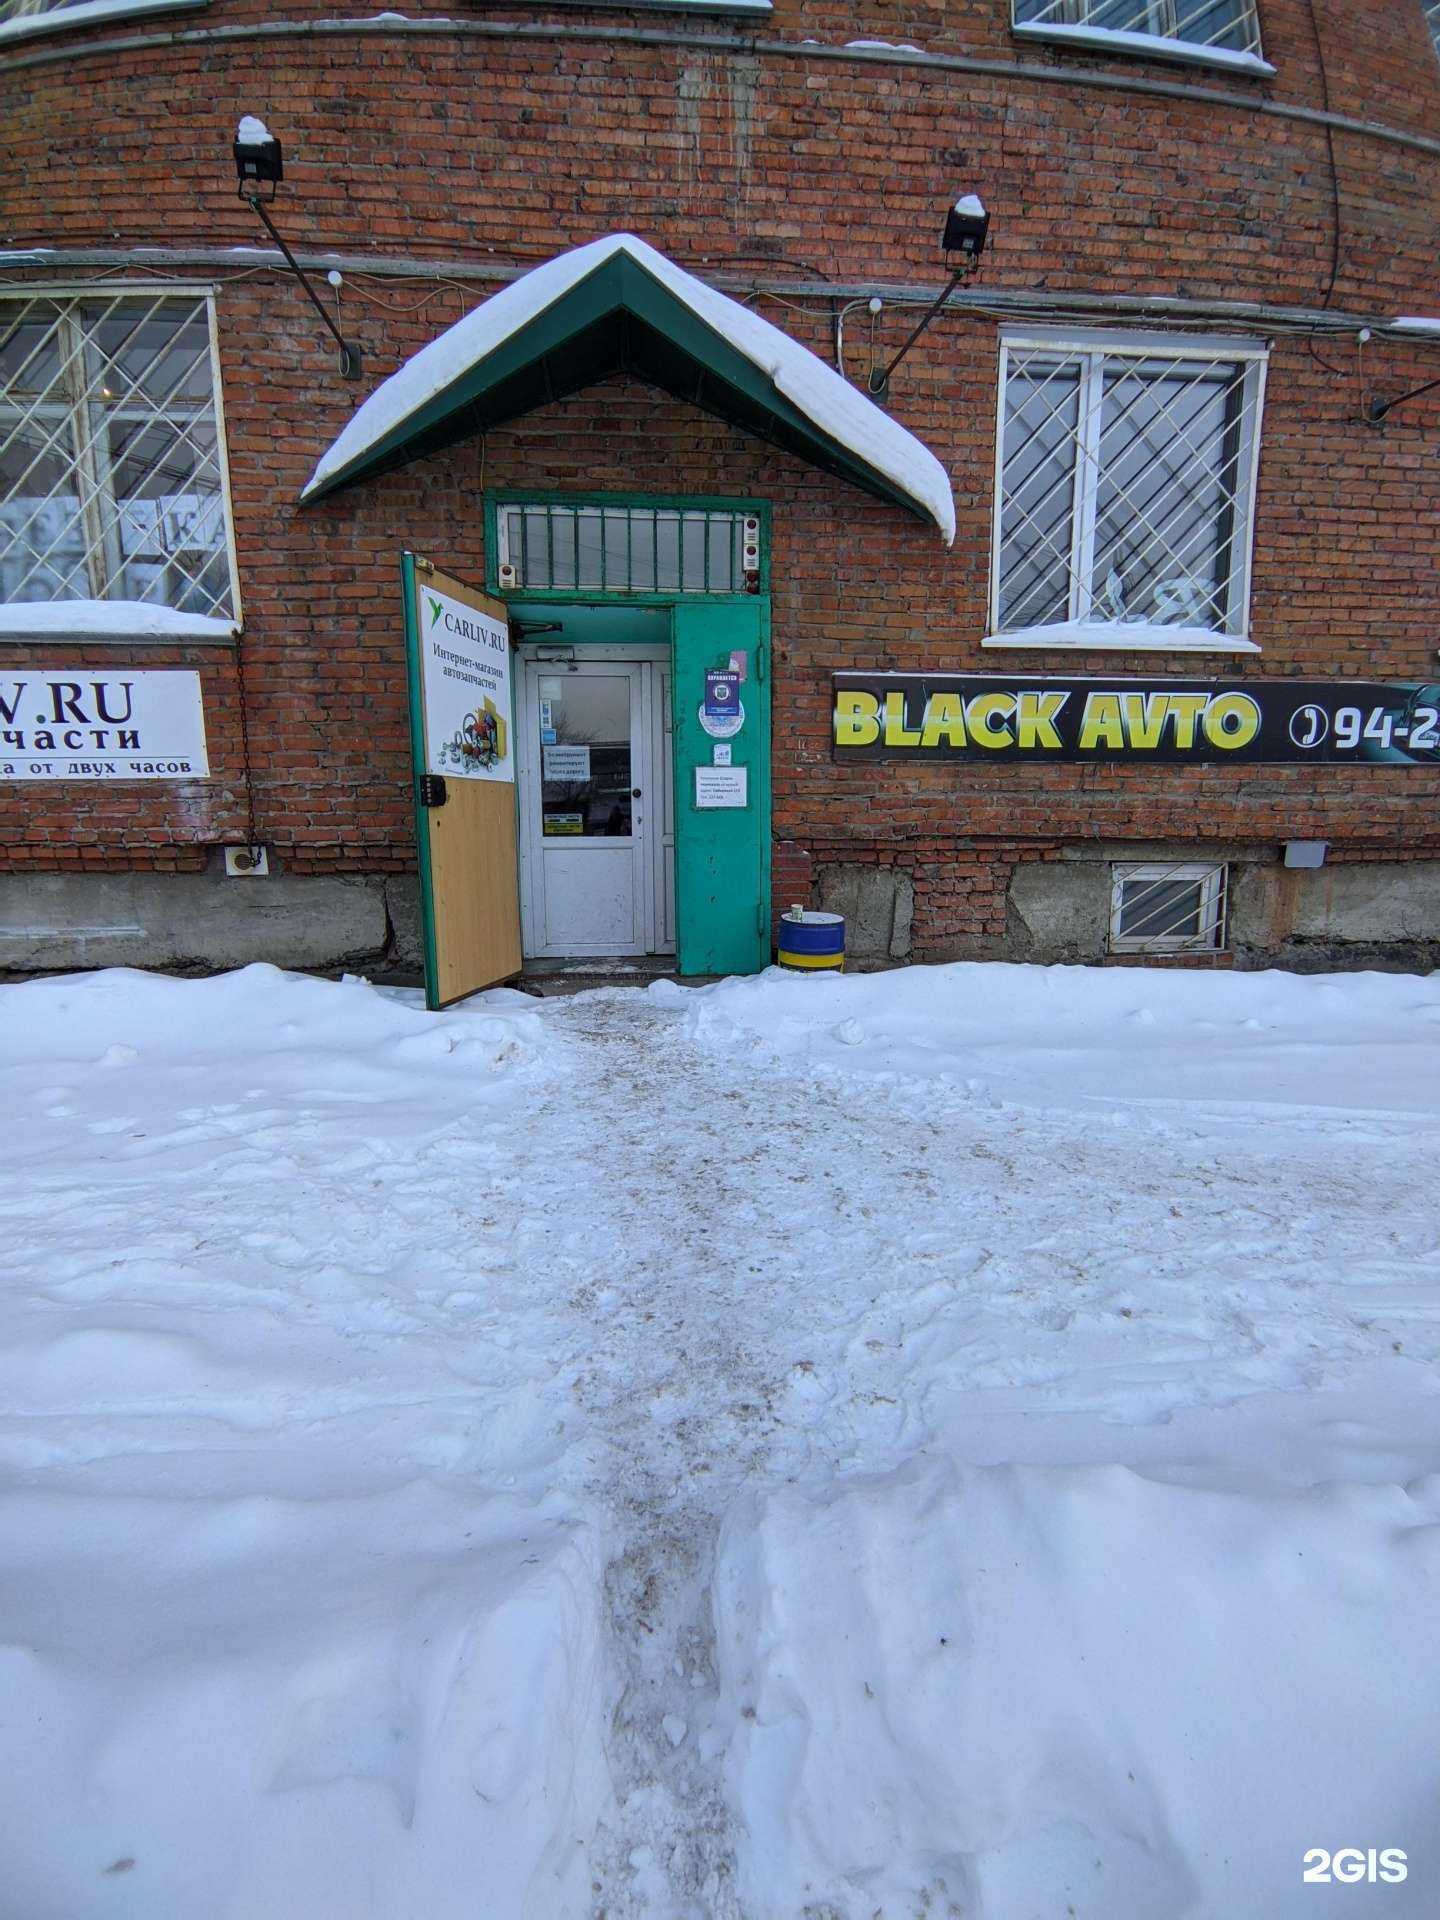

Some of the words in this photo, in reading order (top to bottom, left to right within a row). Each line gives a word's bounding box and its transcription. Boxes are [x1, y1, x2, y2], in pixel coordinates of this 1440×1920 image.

[445, 613, 505, 651] CARLIV.RU
[433, 643, 504, 679] Интернет-магазин
[442, 666, 497, 691] автозапчастей
[834, 690, 1071, 749] BLACK
[1078, 691, 1262, 750] AVTO
[1334, 706, 1438, 749] 94-2
[29, 763, 53, 774] от
[68, 761, 117, 777] двух
[130, 760, 191, 774] часов
